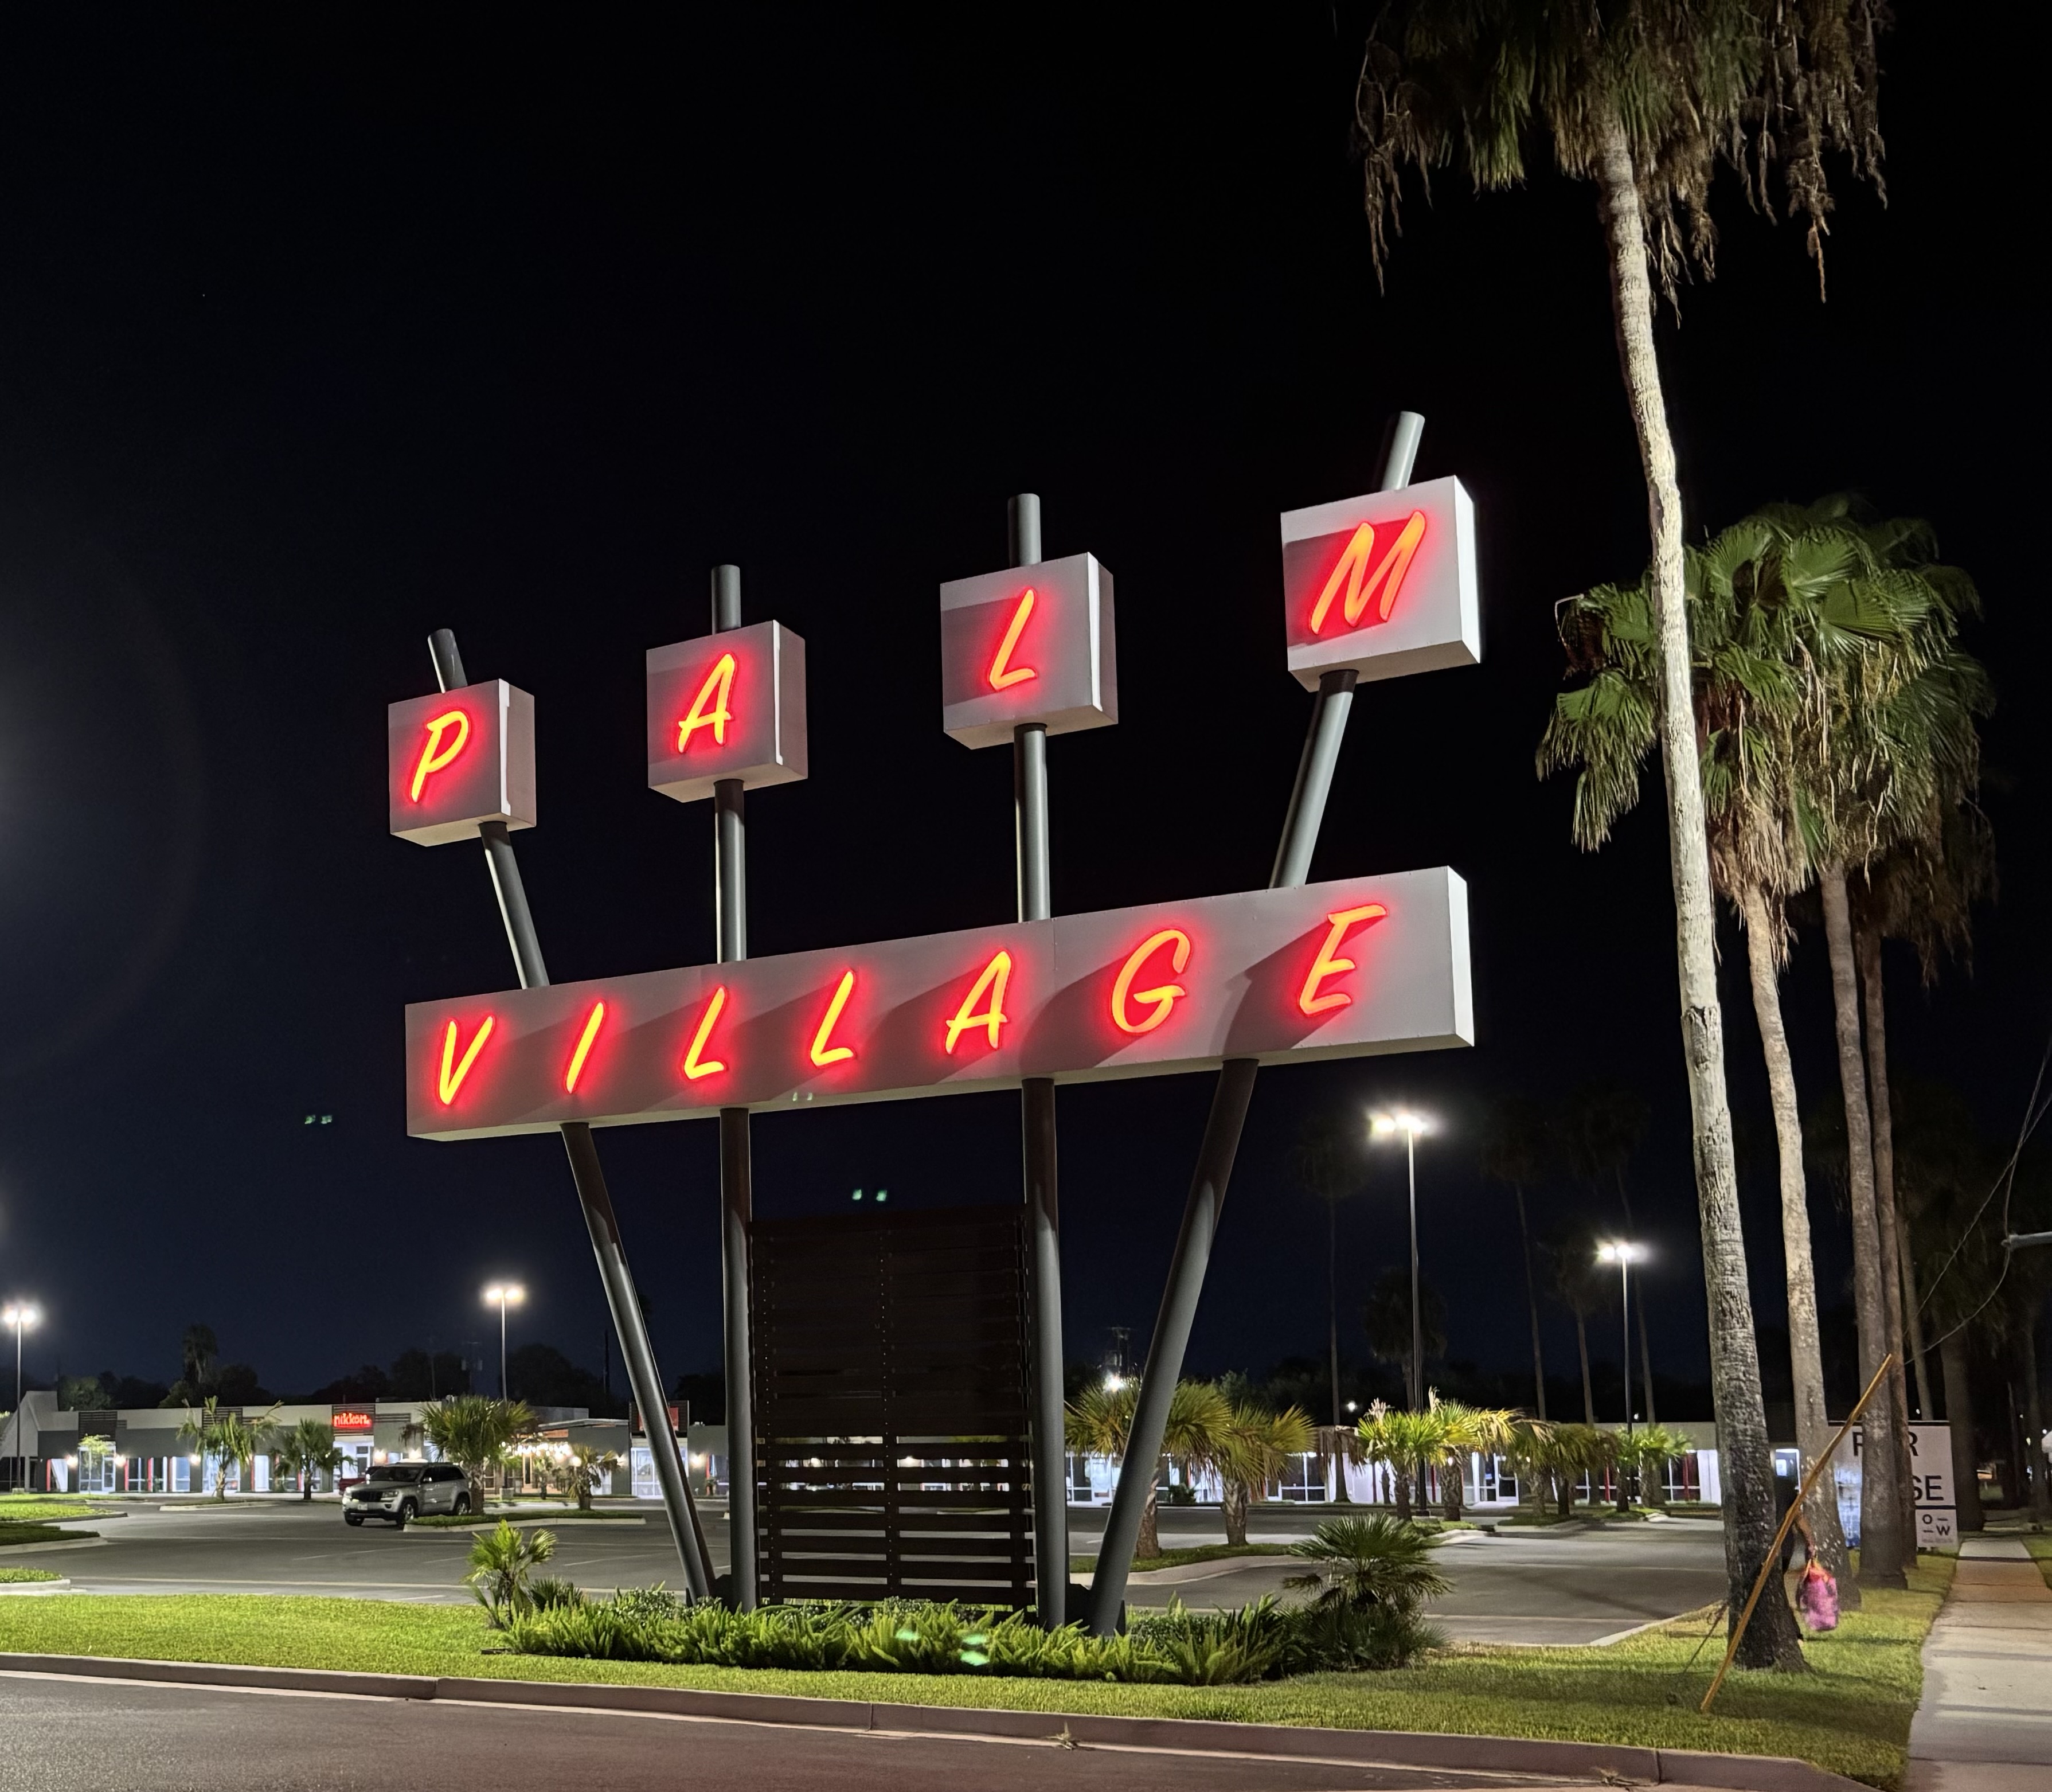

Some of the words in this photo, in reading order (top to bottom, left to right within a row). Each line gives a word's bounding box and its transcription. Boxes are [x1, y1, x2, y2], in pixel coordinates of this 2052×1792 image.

[410, 509, 1426, 803] PALM
[436, 900, 1390, 1107] VILLAGE
[1852, 1431, 1918, 1457] FR
